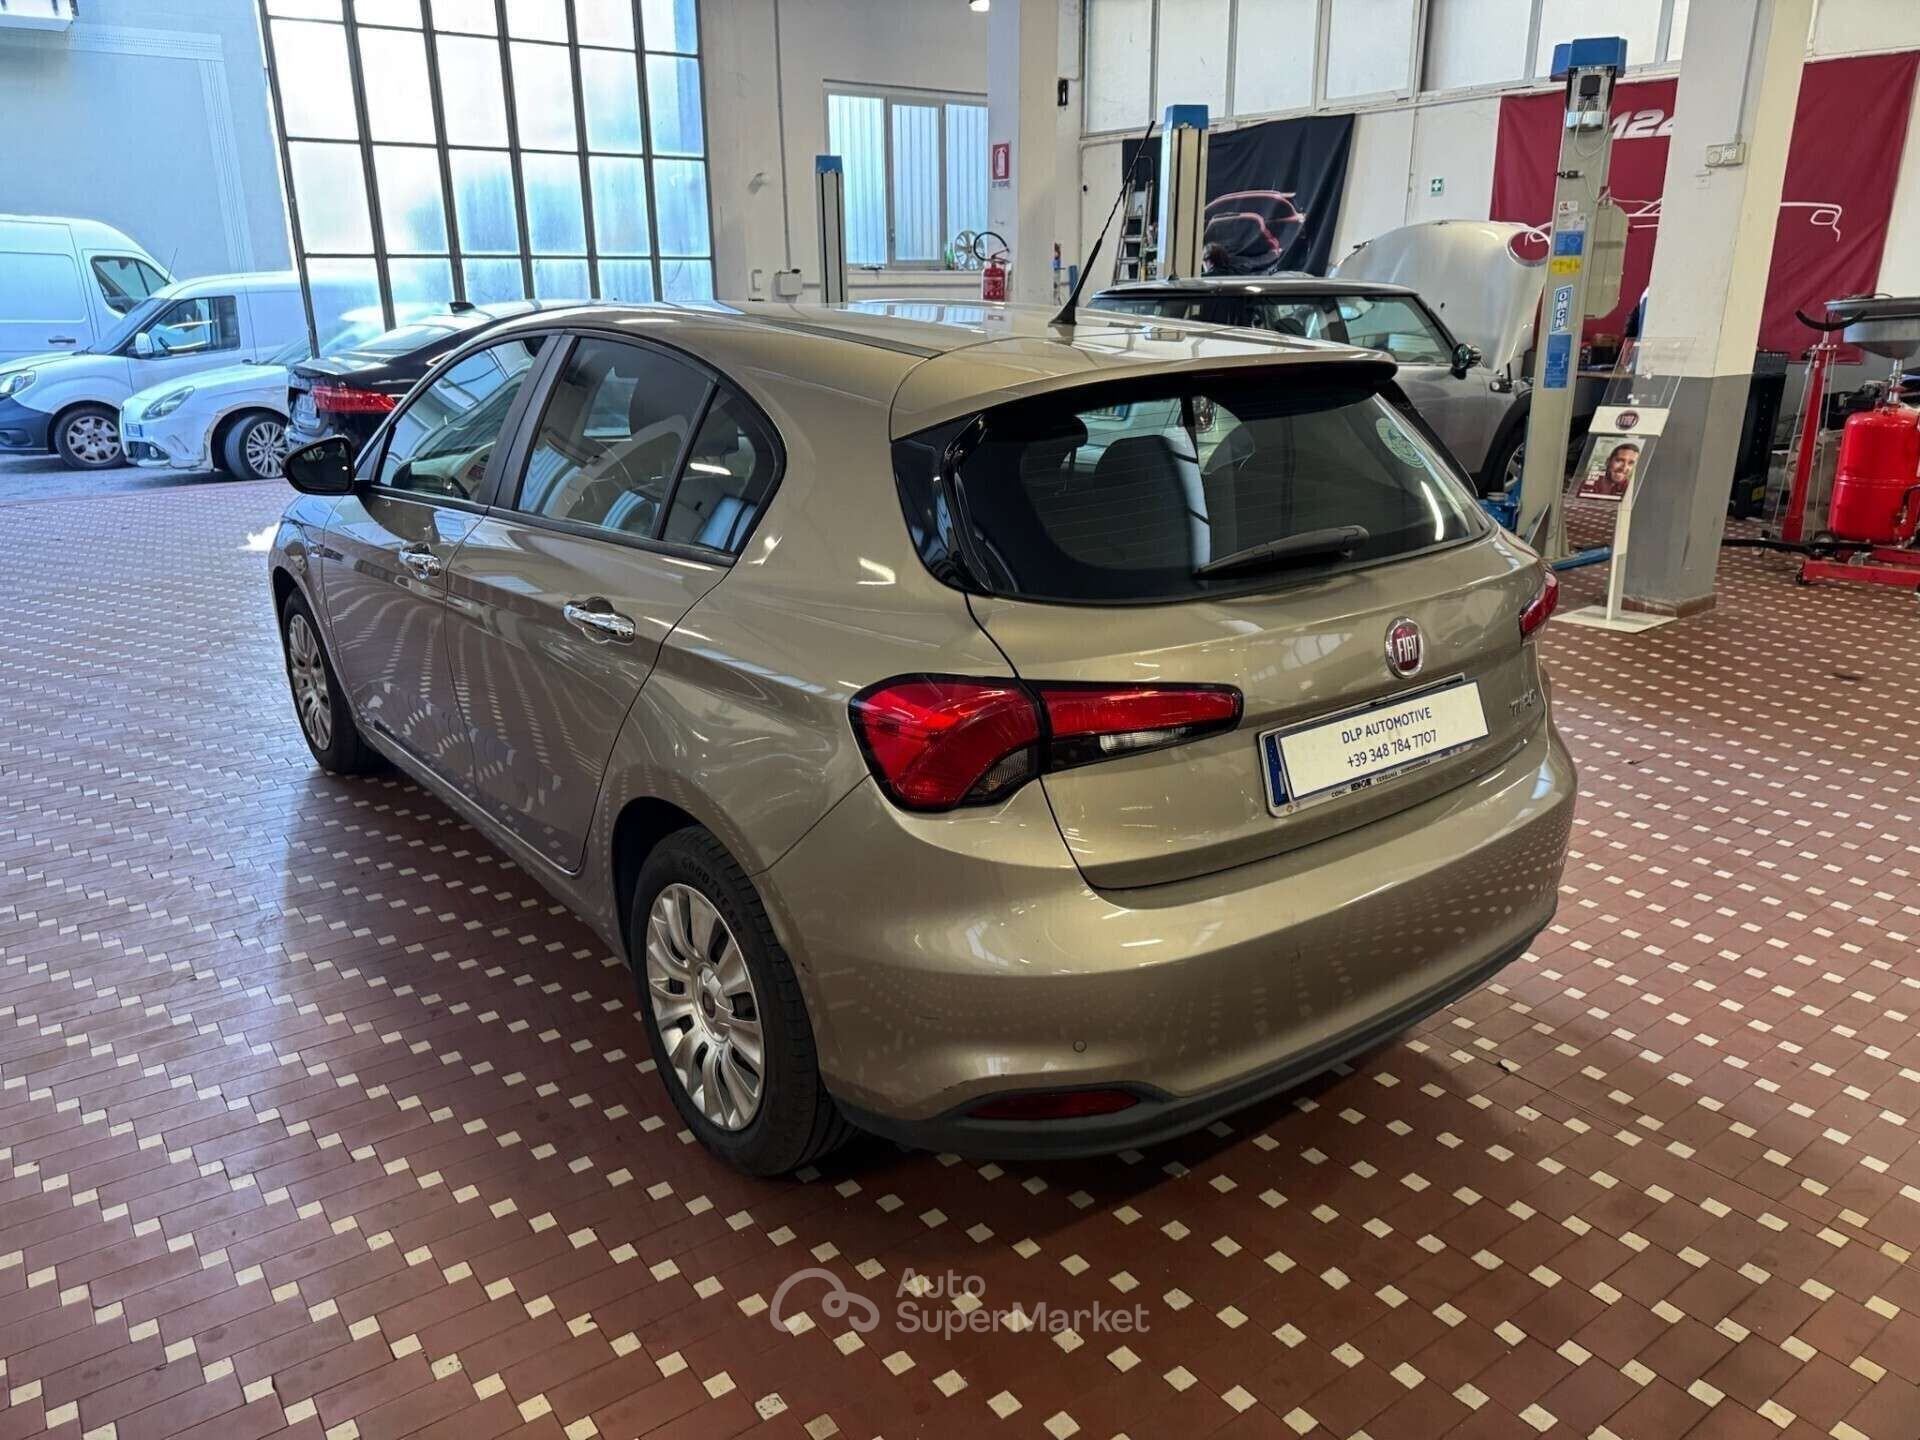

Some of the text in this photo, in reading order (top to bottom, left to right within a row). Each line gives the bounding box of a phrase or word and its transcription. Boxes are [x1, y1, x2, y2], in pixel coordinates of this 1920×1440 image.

[1556, 291, 1568, 328] OMCN
[1396, 634, 1418, 663] FIAT
[1341, 707, 1432, 744] DLP AUTOMOTIVE
[1347, 729, 1437, 768] +39 348 784 7707
